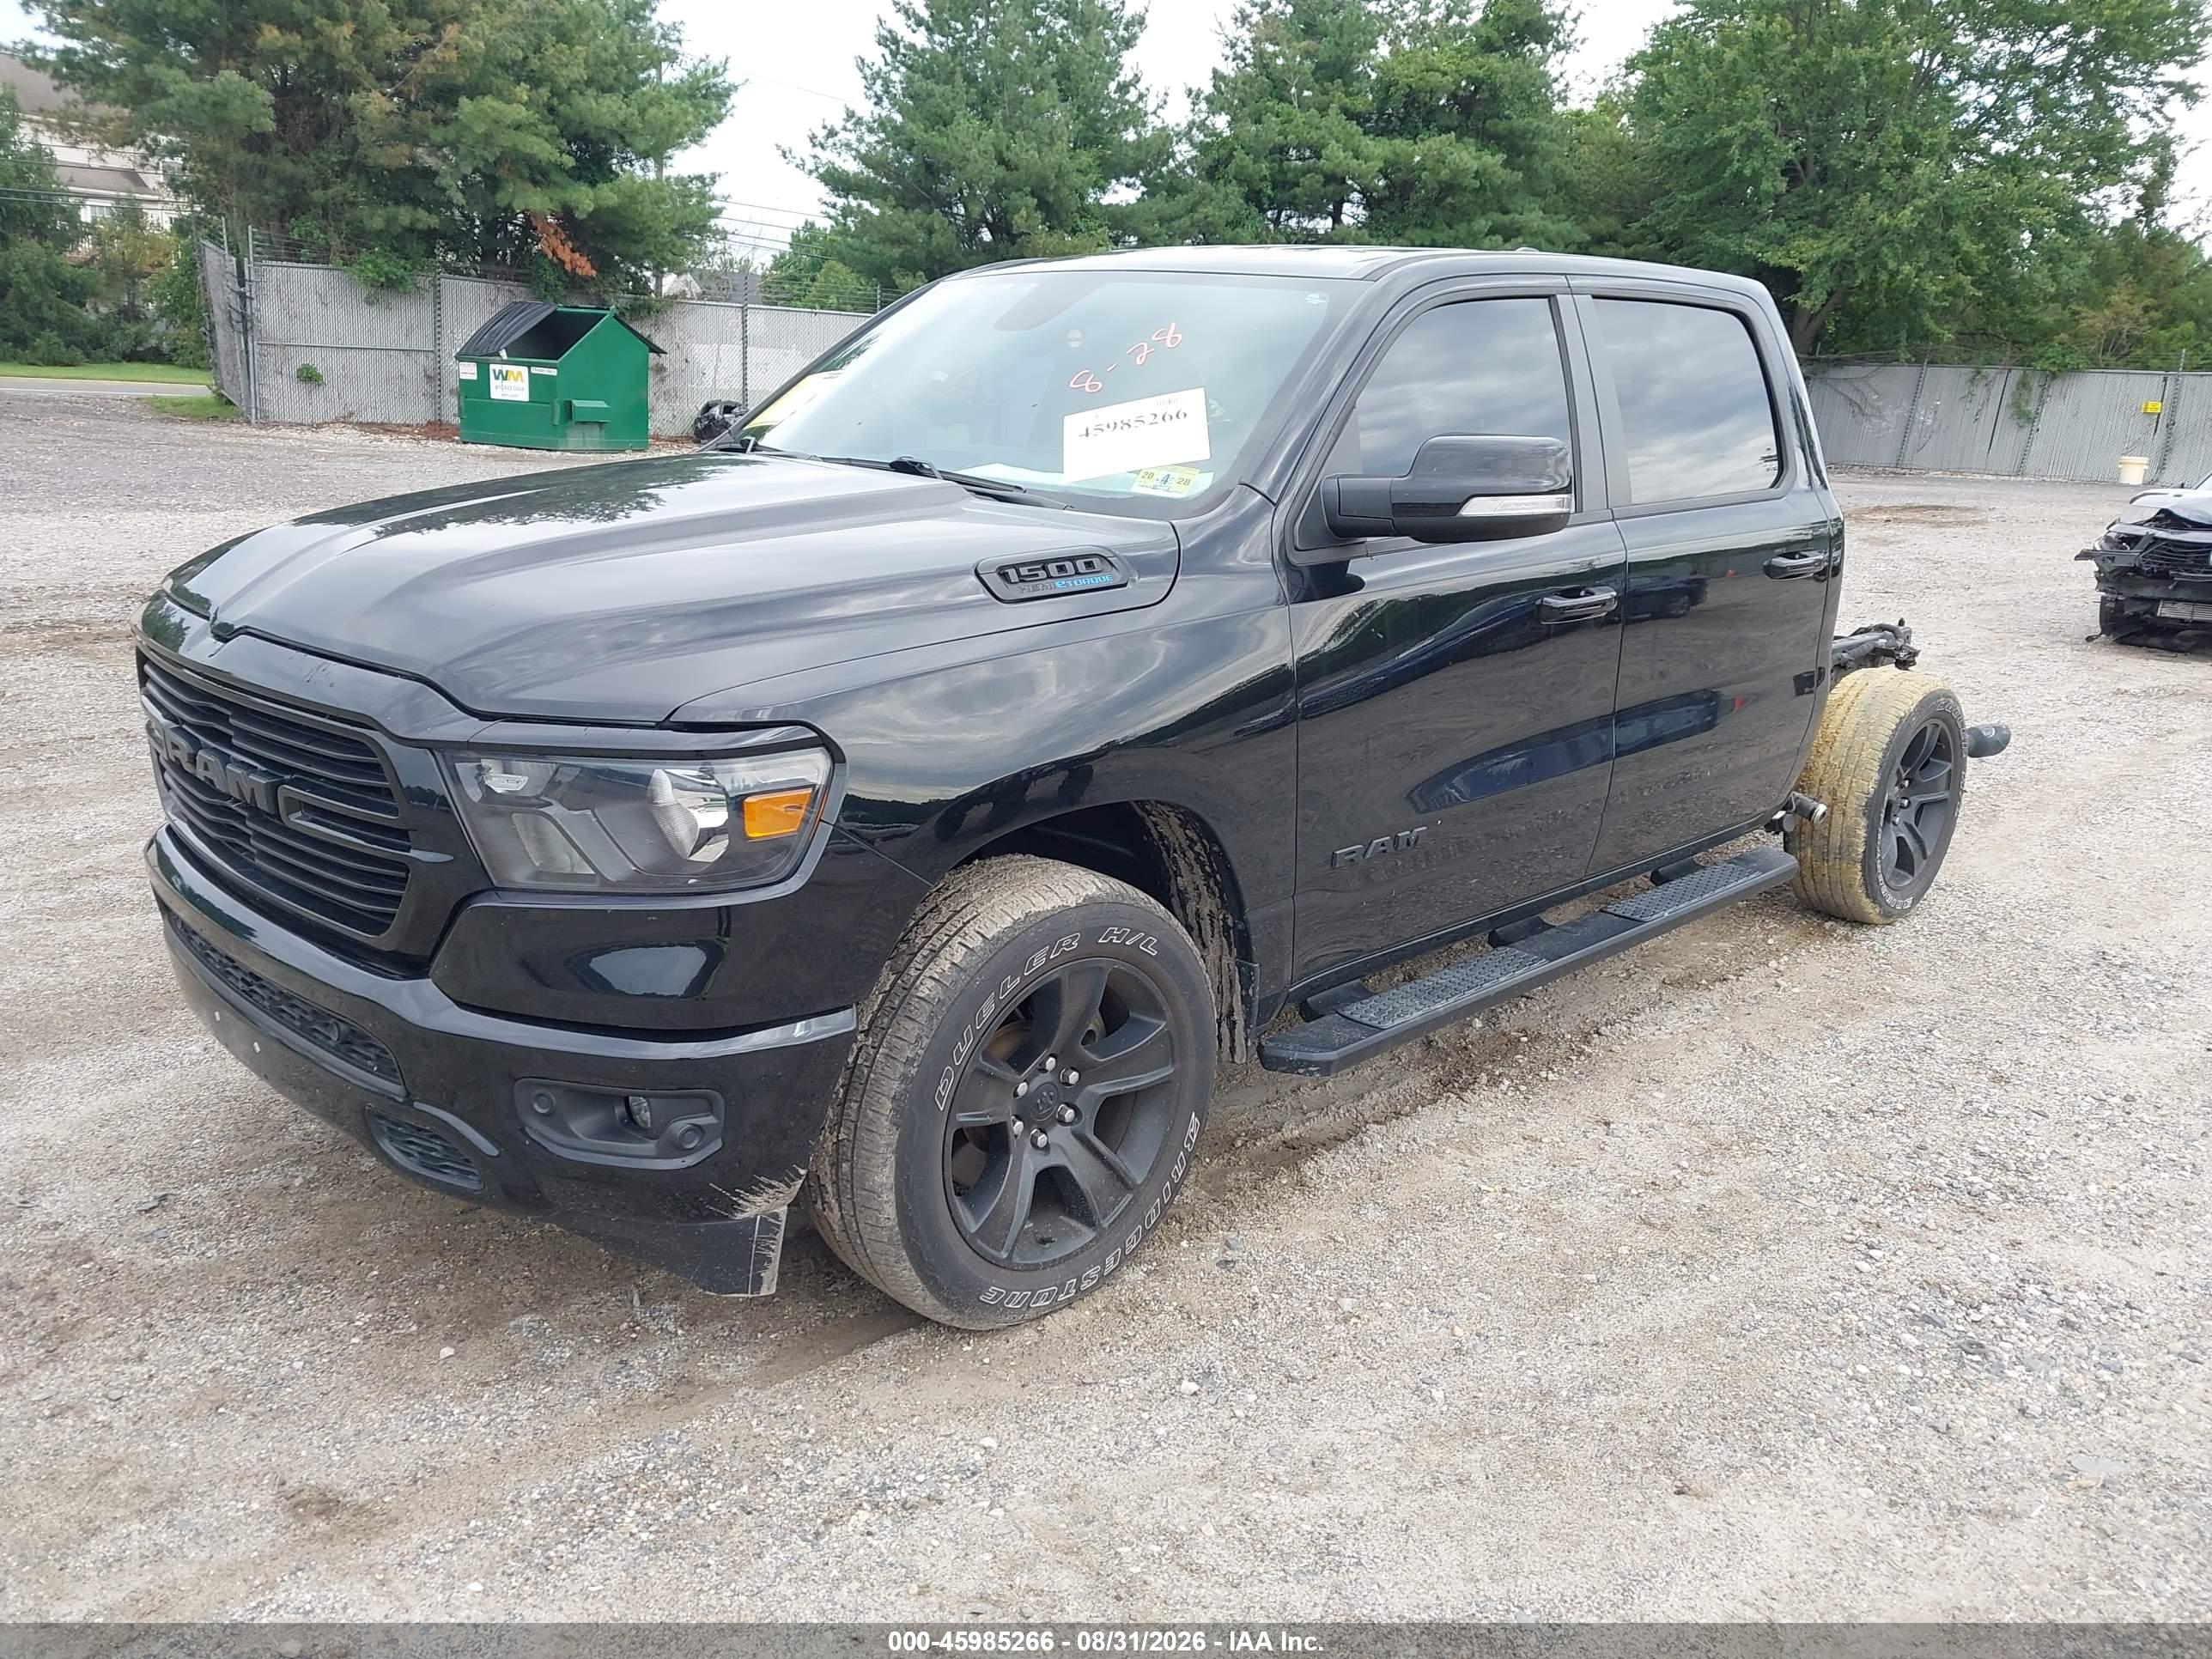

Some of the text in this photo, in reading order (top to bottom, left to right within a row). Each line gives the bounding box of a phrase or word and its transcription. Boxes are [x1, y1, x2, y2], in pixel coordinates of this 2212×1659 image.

[492, 368, 524, 383] WM
[1079, 409, 1188, 438] 45985266
[1141, 471, 1155, 480] 20
[1176, 477, 1192, 486] 28
[1000, 557, 1103, 585] 1500
[161, 724, 285, 815] RAM
[1332, 825, 1429, 868] RAM
[934, 927, 1158, 1111] DUELER H/L
[979, 1111, 1200, 1310] BRIDGESTONE
